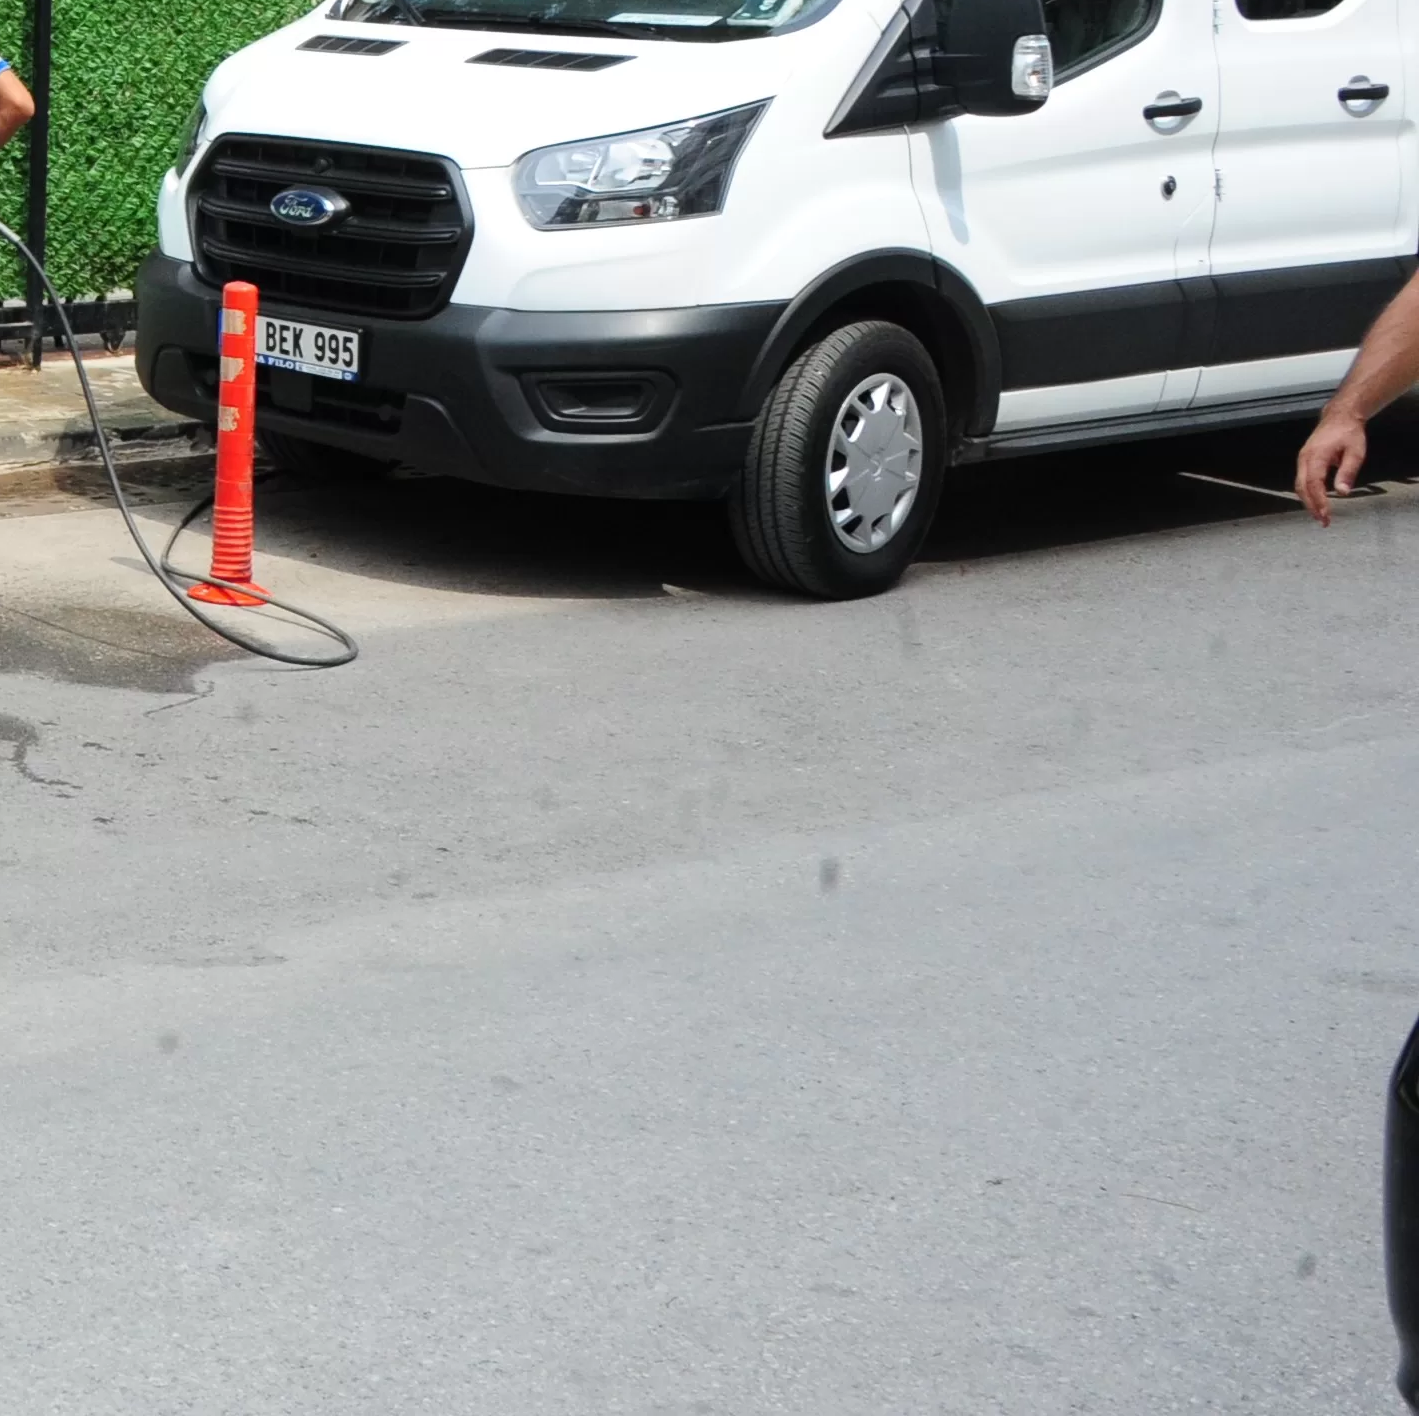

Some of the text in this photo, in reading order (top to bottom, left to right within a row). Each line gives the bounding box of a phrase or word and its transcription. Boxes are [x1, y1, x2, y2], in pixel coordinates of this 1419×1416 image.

[278, 194, 314, 218] Ford
[265, 321, 354, 369] BEK 995
